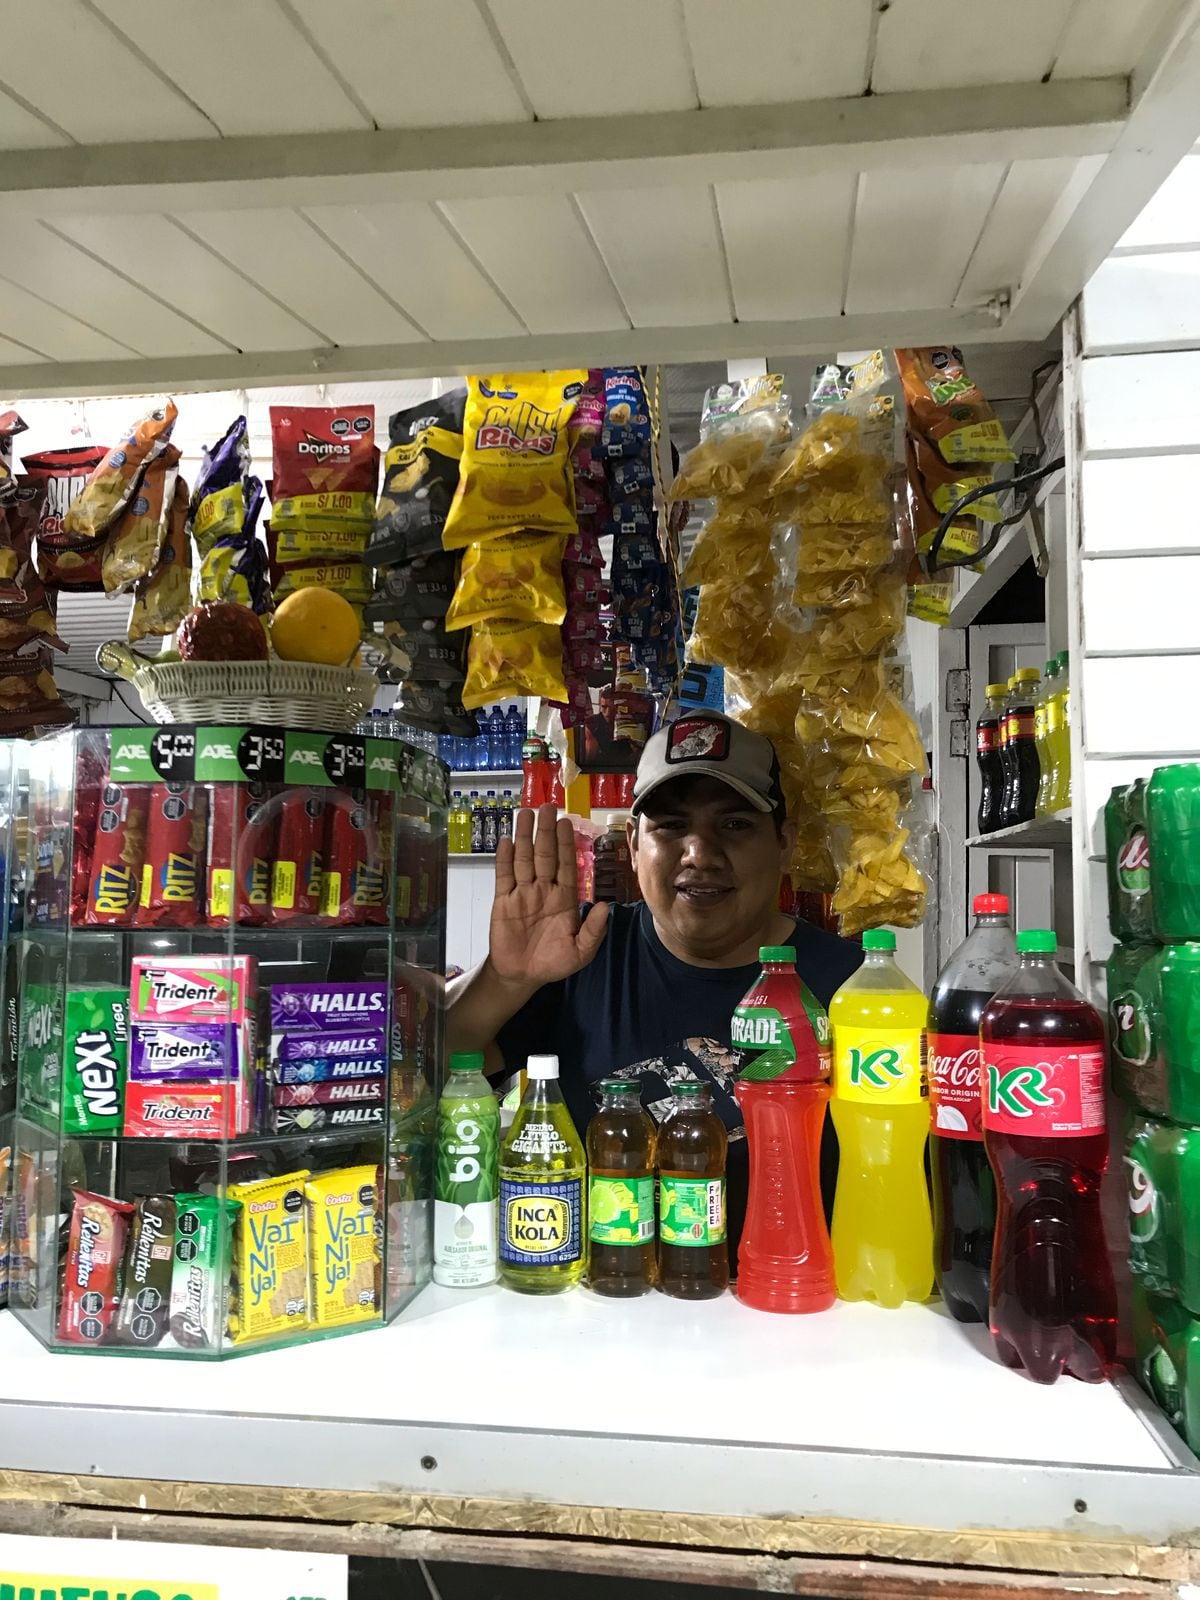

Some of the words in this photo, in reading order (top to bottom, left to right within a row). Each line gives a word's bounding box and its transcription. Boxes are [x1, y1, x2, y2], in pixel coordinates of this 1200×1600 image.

[298, 441, 351, 456] Doritos
[480, 428, 554, 453] Ricas
[331, 495, 352, 509] 1.00
[329, 567, 351, 581] 1.00
[115, 744, 151, 760] AJE
[199, 744, 237, 760] AJE
[288, 749, 324, 766] AJE
[369, 756, 398, 773] AJE
[162, 852, 196, 902] RITZ
[353, 860, 384, 907] RITZ
[95, 864, 131, 914] RITZ
[154, 982, 217, 1000] Trident
[112, 1003, 127, 1042] Línea
[147, 1042, 209, 1058] Trident
[848, 1047, 907, 1089] KR
[986, 1064, 1057, 1118] KR
[73, 1094, 88, 1126] Mentos
[143, 1104, 211, 1120] Trident
[519, 1130, 560, 1141] LITRO
[448, 1119, 481, 1183] bio
[249, 1199, 278, 1215] Costa
[325, 1193, 354, 1207] Costa
[517, 1206, 557, 1222] INCA
[515, 1224, 560, 1240] KOLA
[77, 1216, 101, 1288] Rellenitas
[134, 1211, 162, 1284] Rellenitas
[325, 1235, 351, 1265] Ni
[559, 1250, 579, 1262] 625ml
[249, 1244, 275, 1275] Ni
[250, 1269, 277, 1306] ya!
[325, 1260, 351, 1294] ya!
[183, 1265, 203, 1338] Rellenitas
